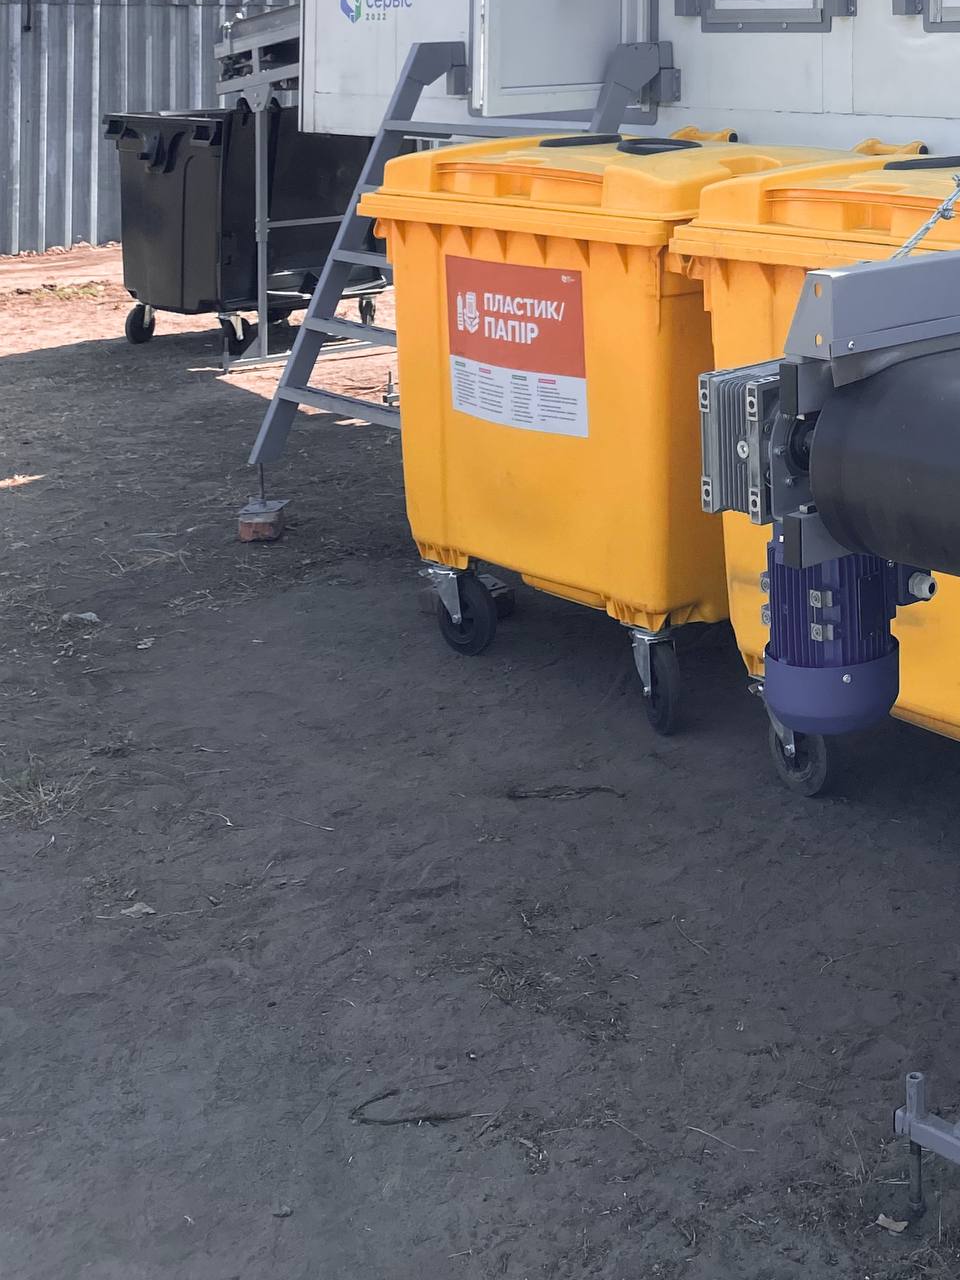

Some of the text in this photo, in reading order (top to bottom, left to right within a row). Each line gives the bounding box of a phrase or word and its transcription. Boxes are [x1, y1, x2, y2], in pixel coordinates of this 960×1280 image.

[366, 13, 387, 21] 2022
[483, 292, 565, 322] ПЛАСТИК/
[484, 316, 539, 345] ПАПІР
